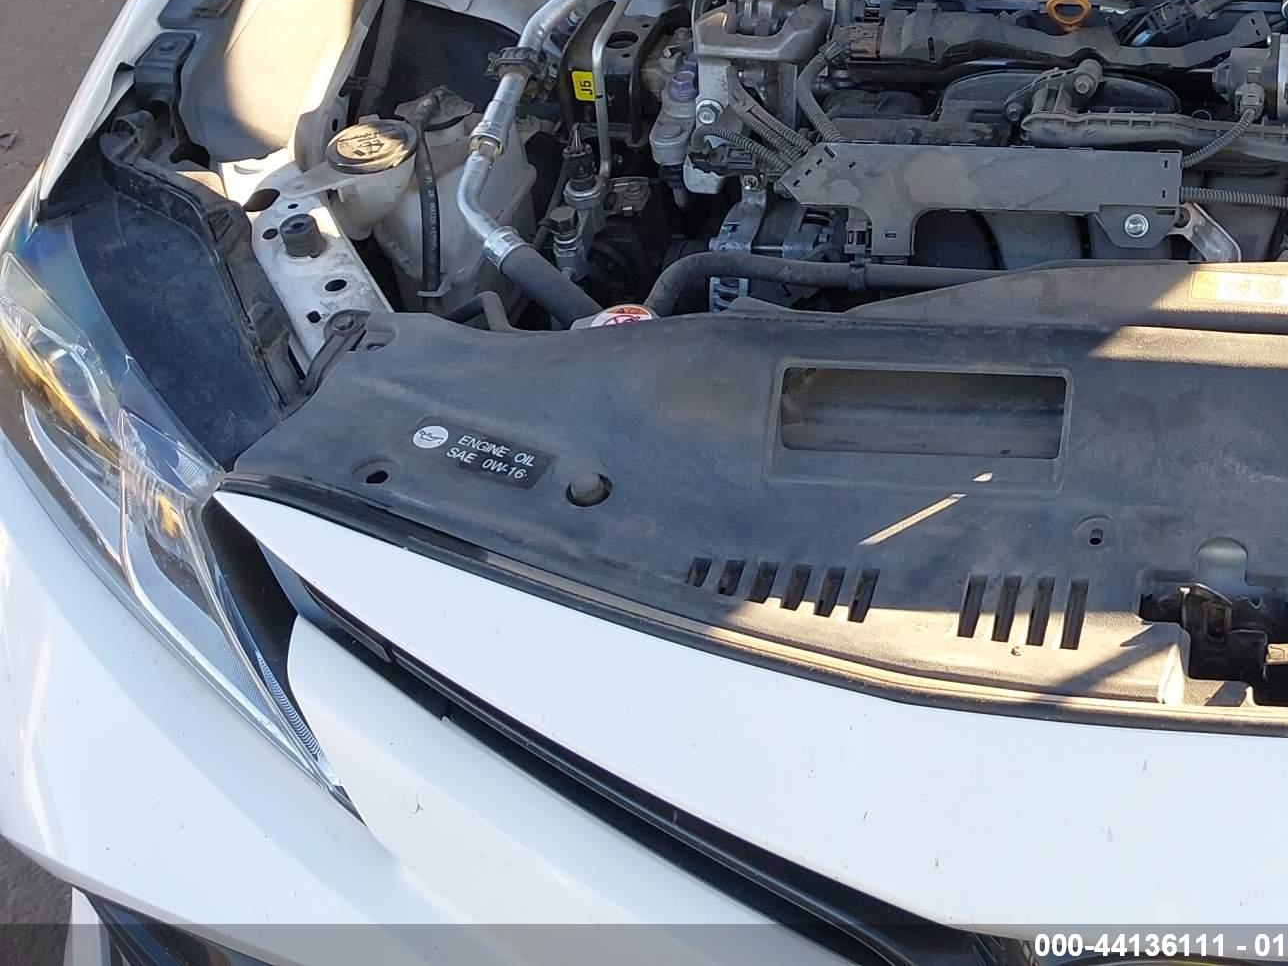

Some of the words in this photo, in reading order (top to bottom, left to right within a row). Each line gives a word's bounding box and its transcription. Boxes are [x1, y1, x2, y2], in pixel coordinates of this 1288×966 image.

[580, 81, 593, 95] J5
[446, 447, 477, 463] SAE
[482, 458, 527, 479] 0W-16
[458, 435, 510, 458] ENGINE
[514, 452, 536, 467] OIL
